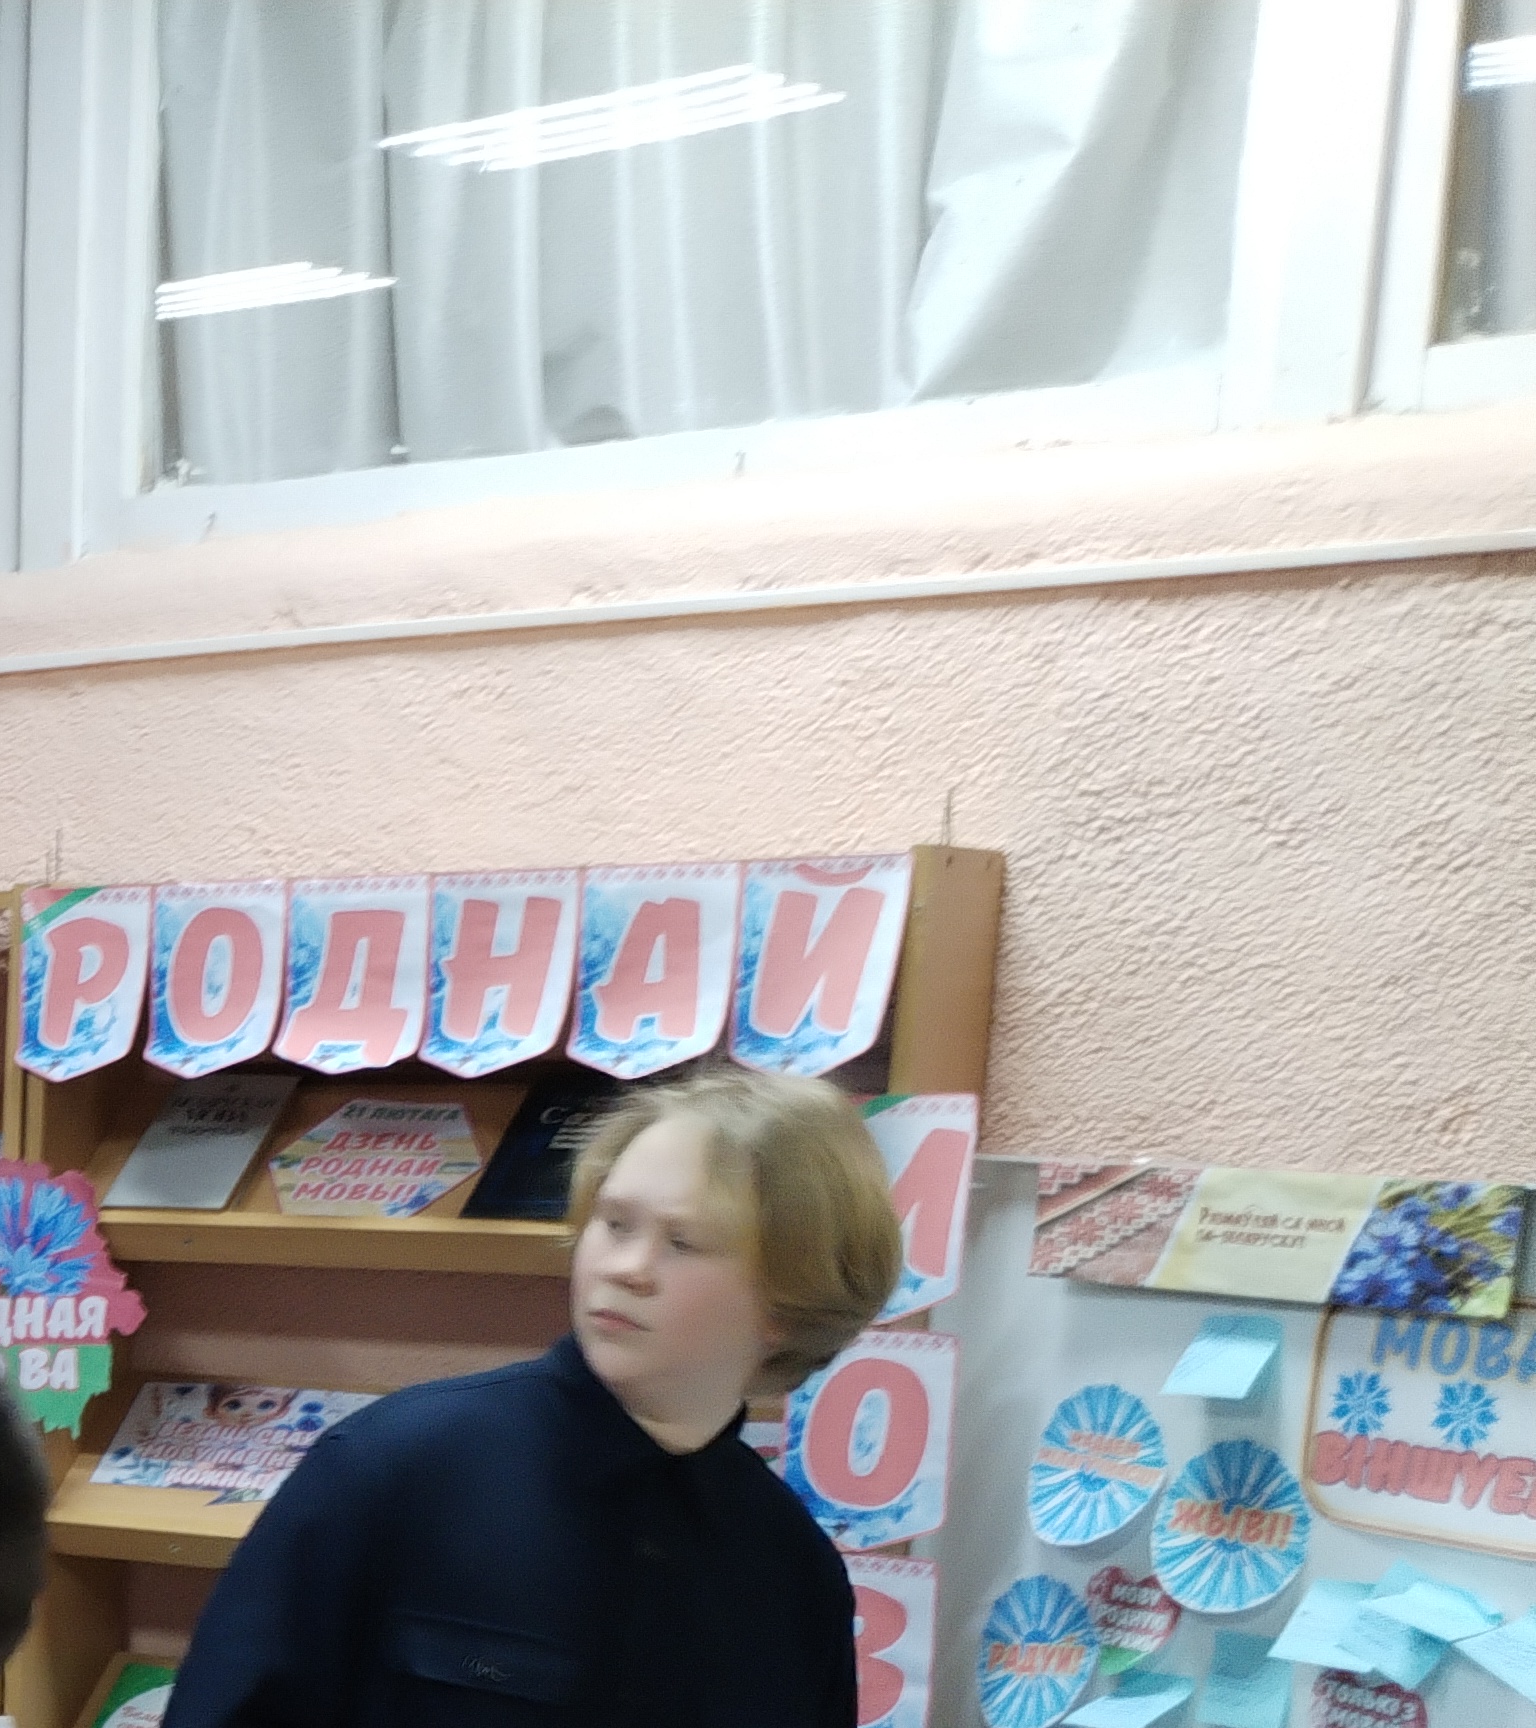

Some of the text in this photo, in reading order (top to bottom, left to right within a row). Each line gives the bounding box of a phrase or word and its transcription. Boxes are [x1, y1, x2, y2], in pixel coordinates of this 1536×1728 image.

[43, 863, 887, 1065] РОДНАЙ
[322, 1131, 439, 1151] ДЗЕНЬ
[298, 1153, 443, 1177] РОДНАЙ
[292, 1182, 419, 1202] МОВЫ!
[1311, 1430, 1536, 1519] ВІНШУЕ
